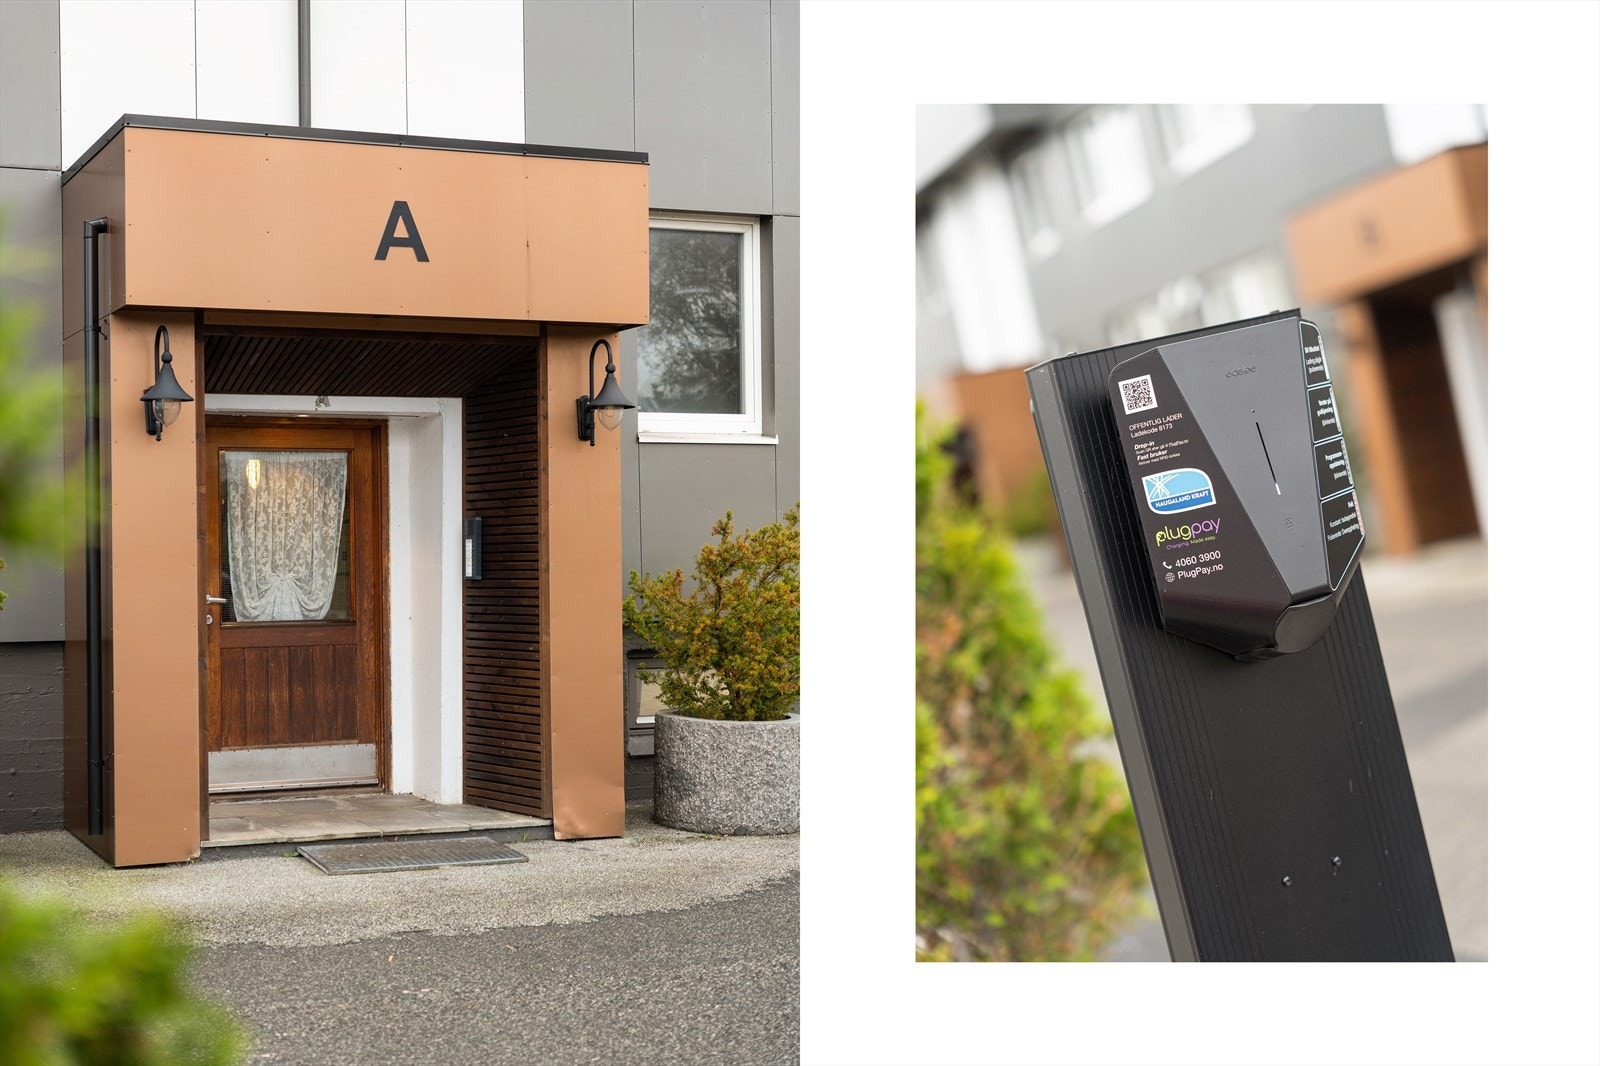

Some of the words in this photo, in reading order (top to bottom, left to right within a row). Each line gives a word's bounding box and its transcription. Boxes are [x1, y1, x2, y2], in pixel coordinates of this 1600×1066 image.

[374, 200, 430, 262] A
[1162, 413, 1183, 422] LADER
[1131, 427, 1158, 438] Ladekode
[1135, 441, 1155, 450] Drop-in
[1150, 449, 1168, 458] bruker
[1155, 495, 1191, 508] HAUGALAND
[1191, 490, 1209, 500] KRAFT
[1156, 518, 1220, 547] plugpay
[1175, 556, 1197, 567] 4060
[1199, 550, 1221, 562] 3900
[1177, 564, 1224, 579] PlugPay.no
